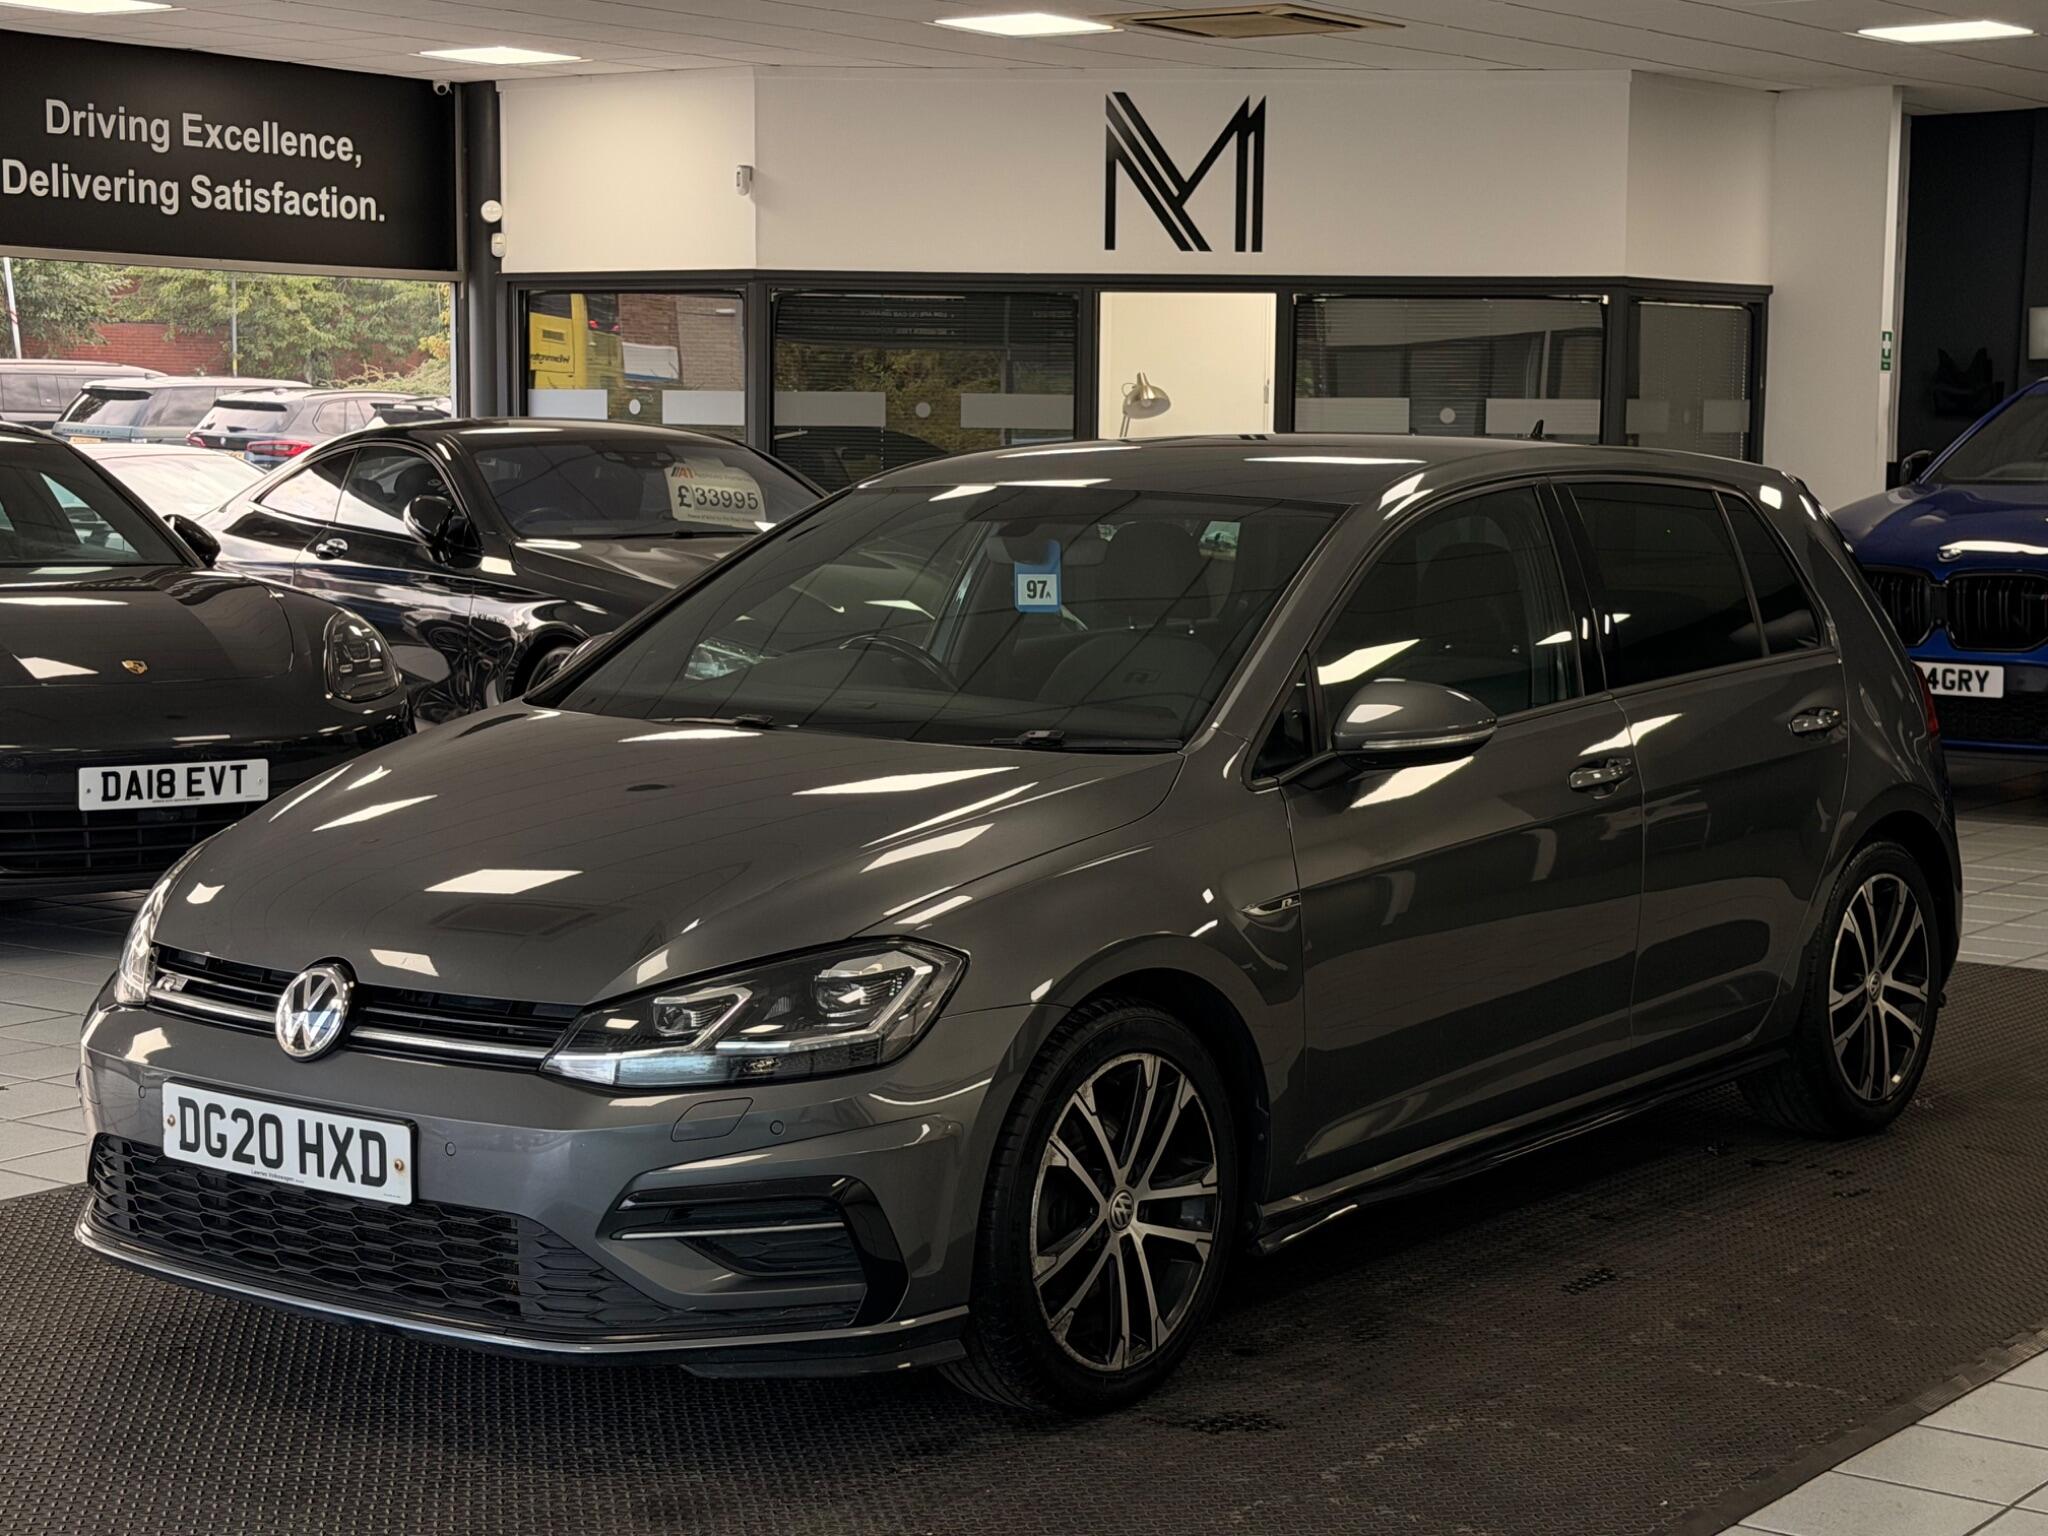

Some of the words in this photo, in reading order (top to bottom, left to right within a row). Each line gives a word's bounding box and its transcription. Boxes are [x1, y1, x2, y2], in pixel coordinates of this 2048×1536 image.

[45, 98, 171, 153] Driving
[182, 112, 363, 168] Excellence,
[2, 158, 180, 215] Delivering
[190, 174, 386, 222] Satisfaction.
[1927, 667, 1990, 693] 4GRY
[101, 768, 176, 802] DA18
[186, 764, 248, 797] EVT
[177, 1096, 284, 1170] DG20
[297, 1118, 388, 1188] HXD
